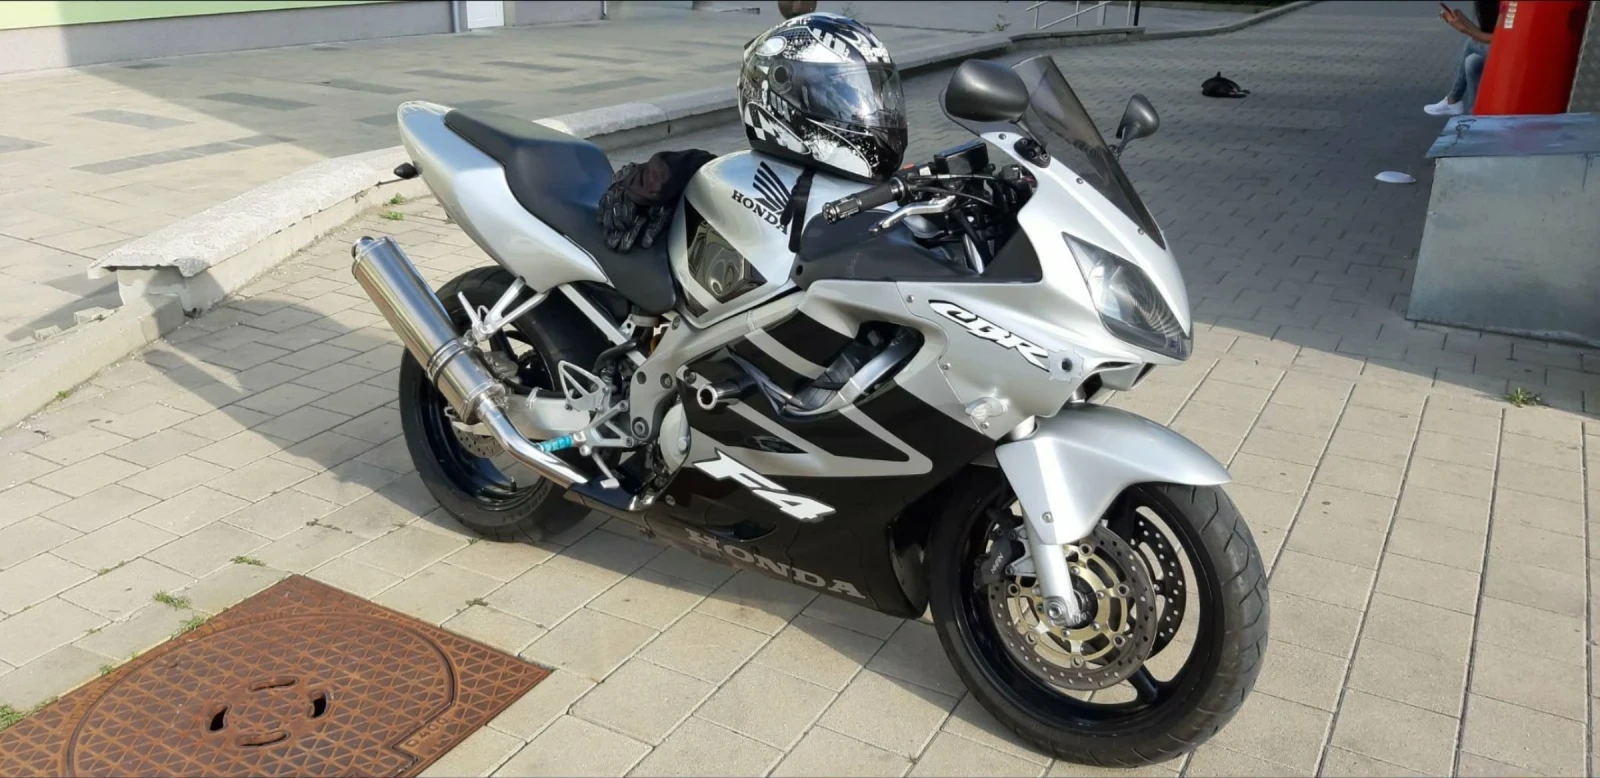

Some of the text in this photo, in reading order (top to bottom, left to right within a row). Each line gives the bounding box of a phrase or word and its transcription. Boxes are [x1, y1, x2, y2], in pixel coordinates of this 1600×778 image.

[731, 190, 788, 235] HONDA
[928, 300, 1050, 373] CBR
[692, 447, 836, 522] F4
[685, 528, 866, 599] HONDA
